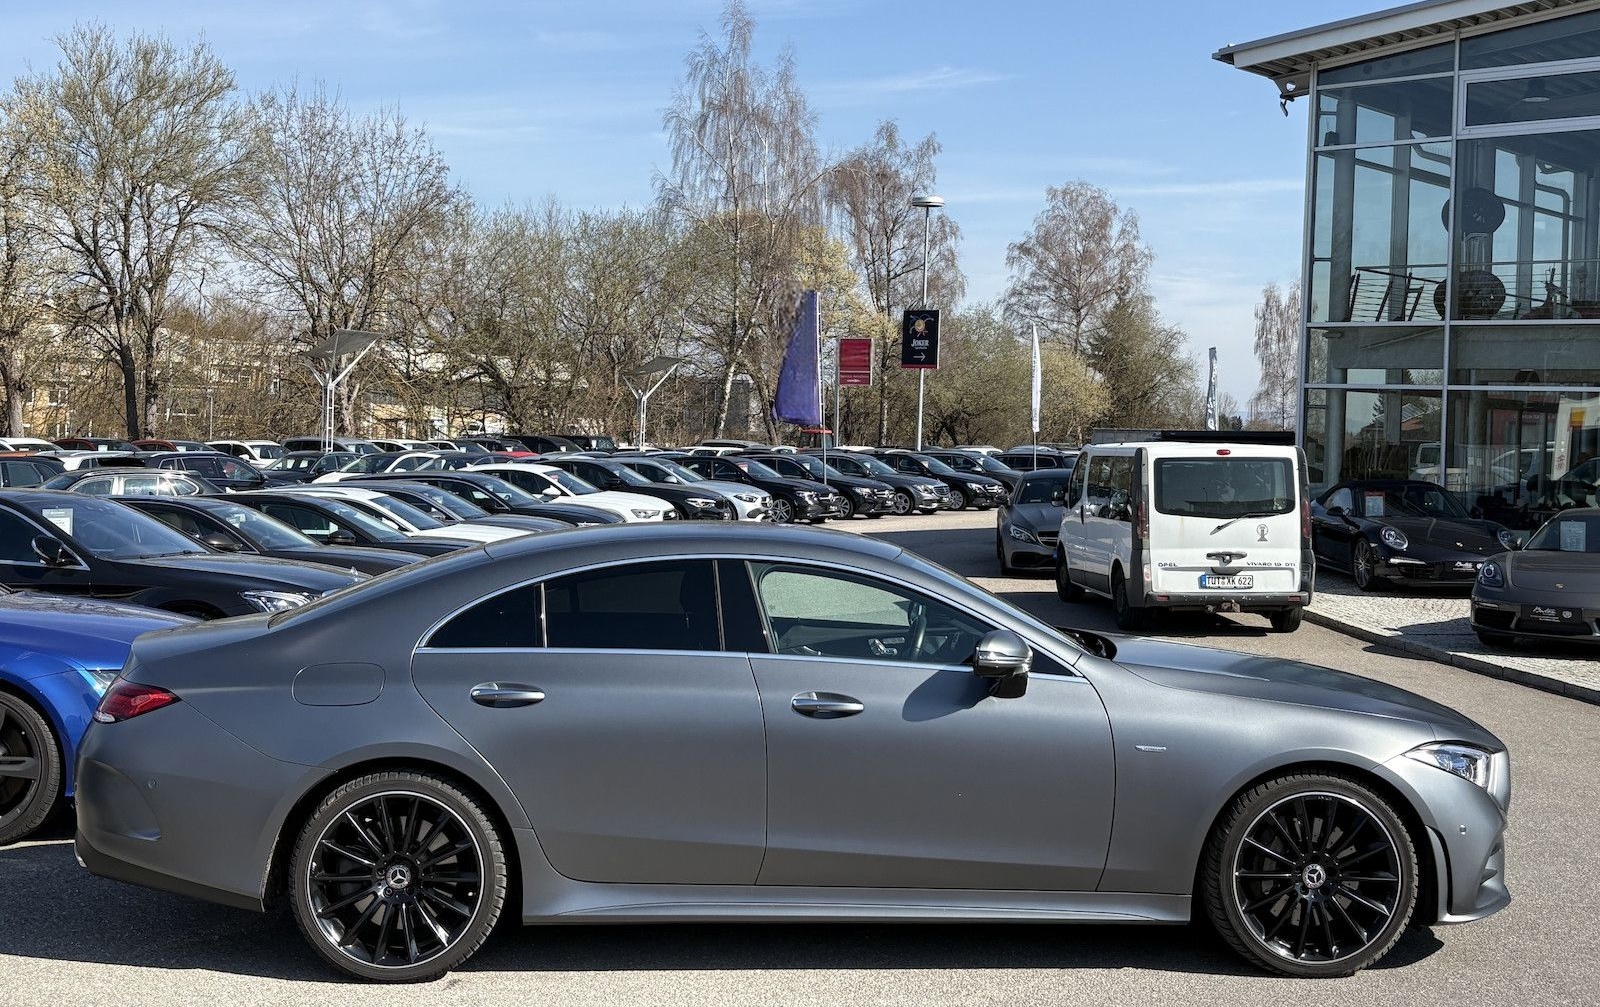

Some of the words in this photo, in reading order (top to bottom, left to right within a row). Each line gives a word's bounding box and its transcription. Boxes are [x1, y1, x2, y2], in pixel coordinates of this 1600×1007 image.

[1207, 576, 1221, 585] TUT
[1227, 576, 1236, 585] XK
[1238, 577, 1252, 586] 622
